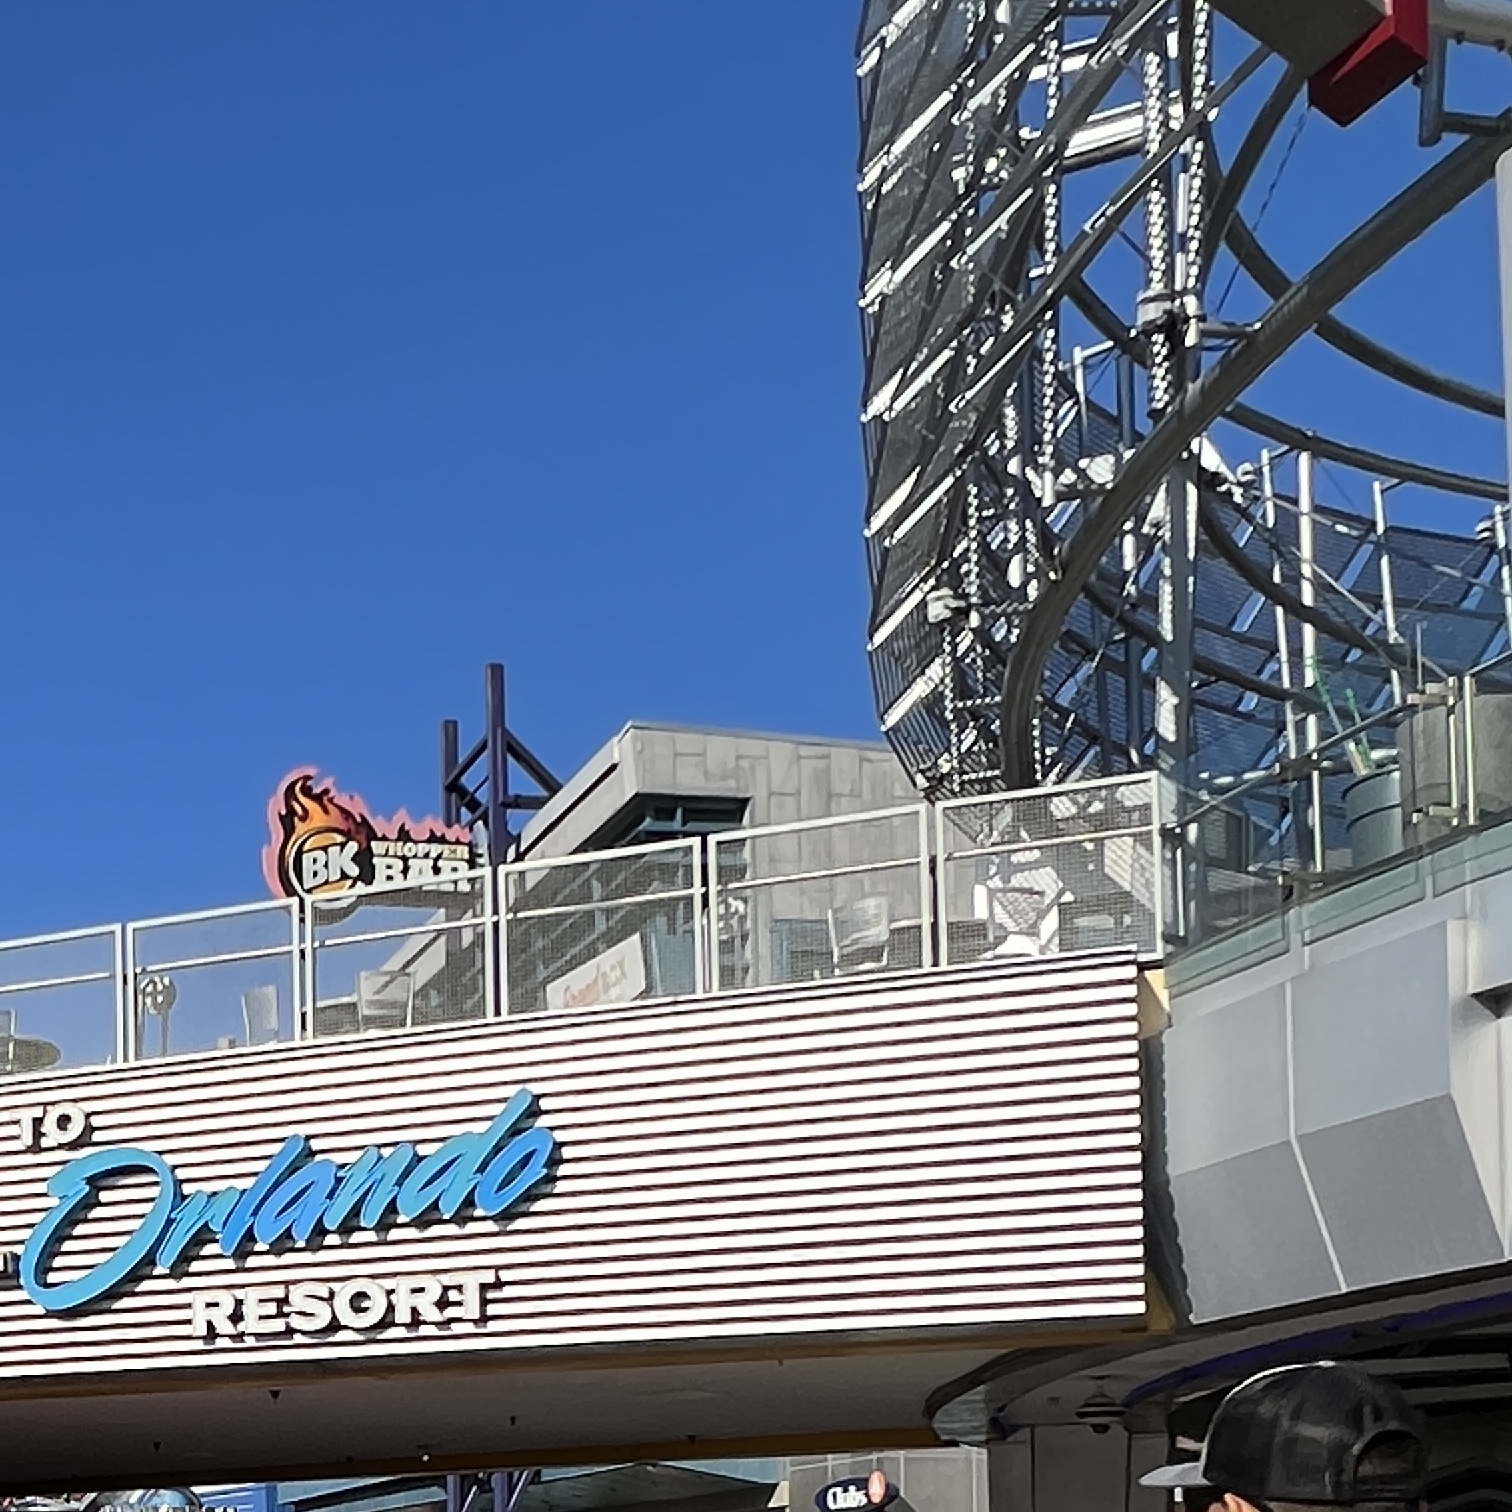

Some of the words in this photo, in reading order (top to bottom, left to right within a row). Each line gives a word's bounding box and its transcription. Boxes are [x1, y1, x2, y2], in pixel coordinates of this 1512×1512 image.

[302, 840, 360, 890] BK
[370, 840, 470, 860] WHOPPER
[371, 857, 472, 892] BAR
[11, 1102, 91, 1149] TO
[18, 1086, 556, 1311] Orlando
[191, 1268, 498, 1339] RESORT
